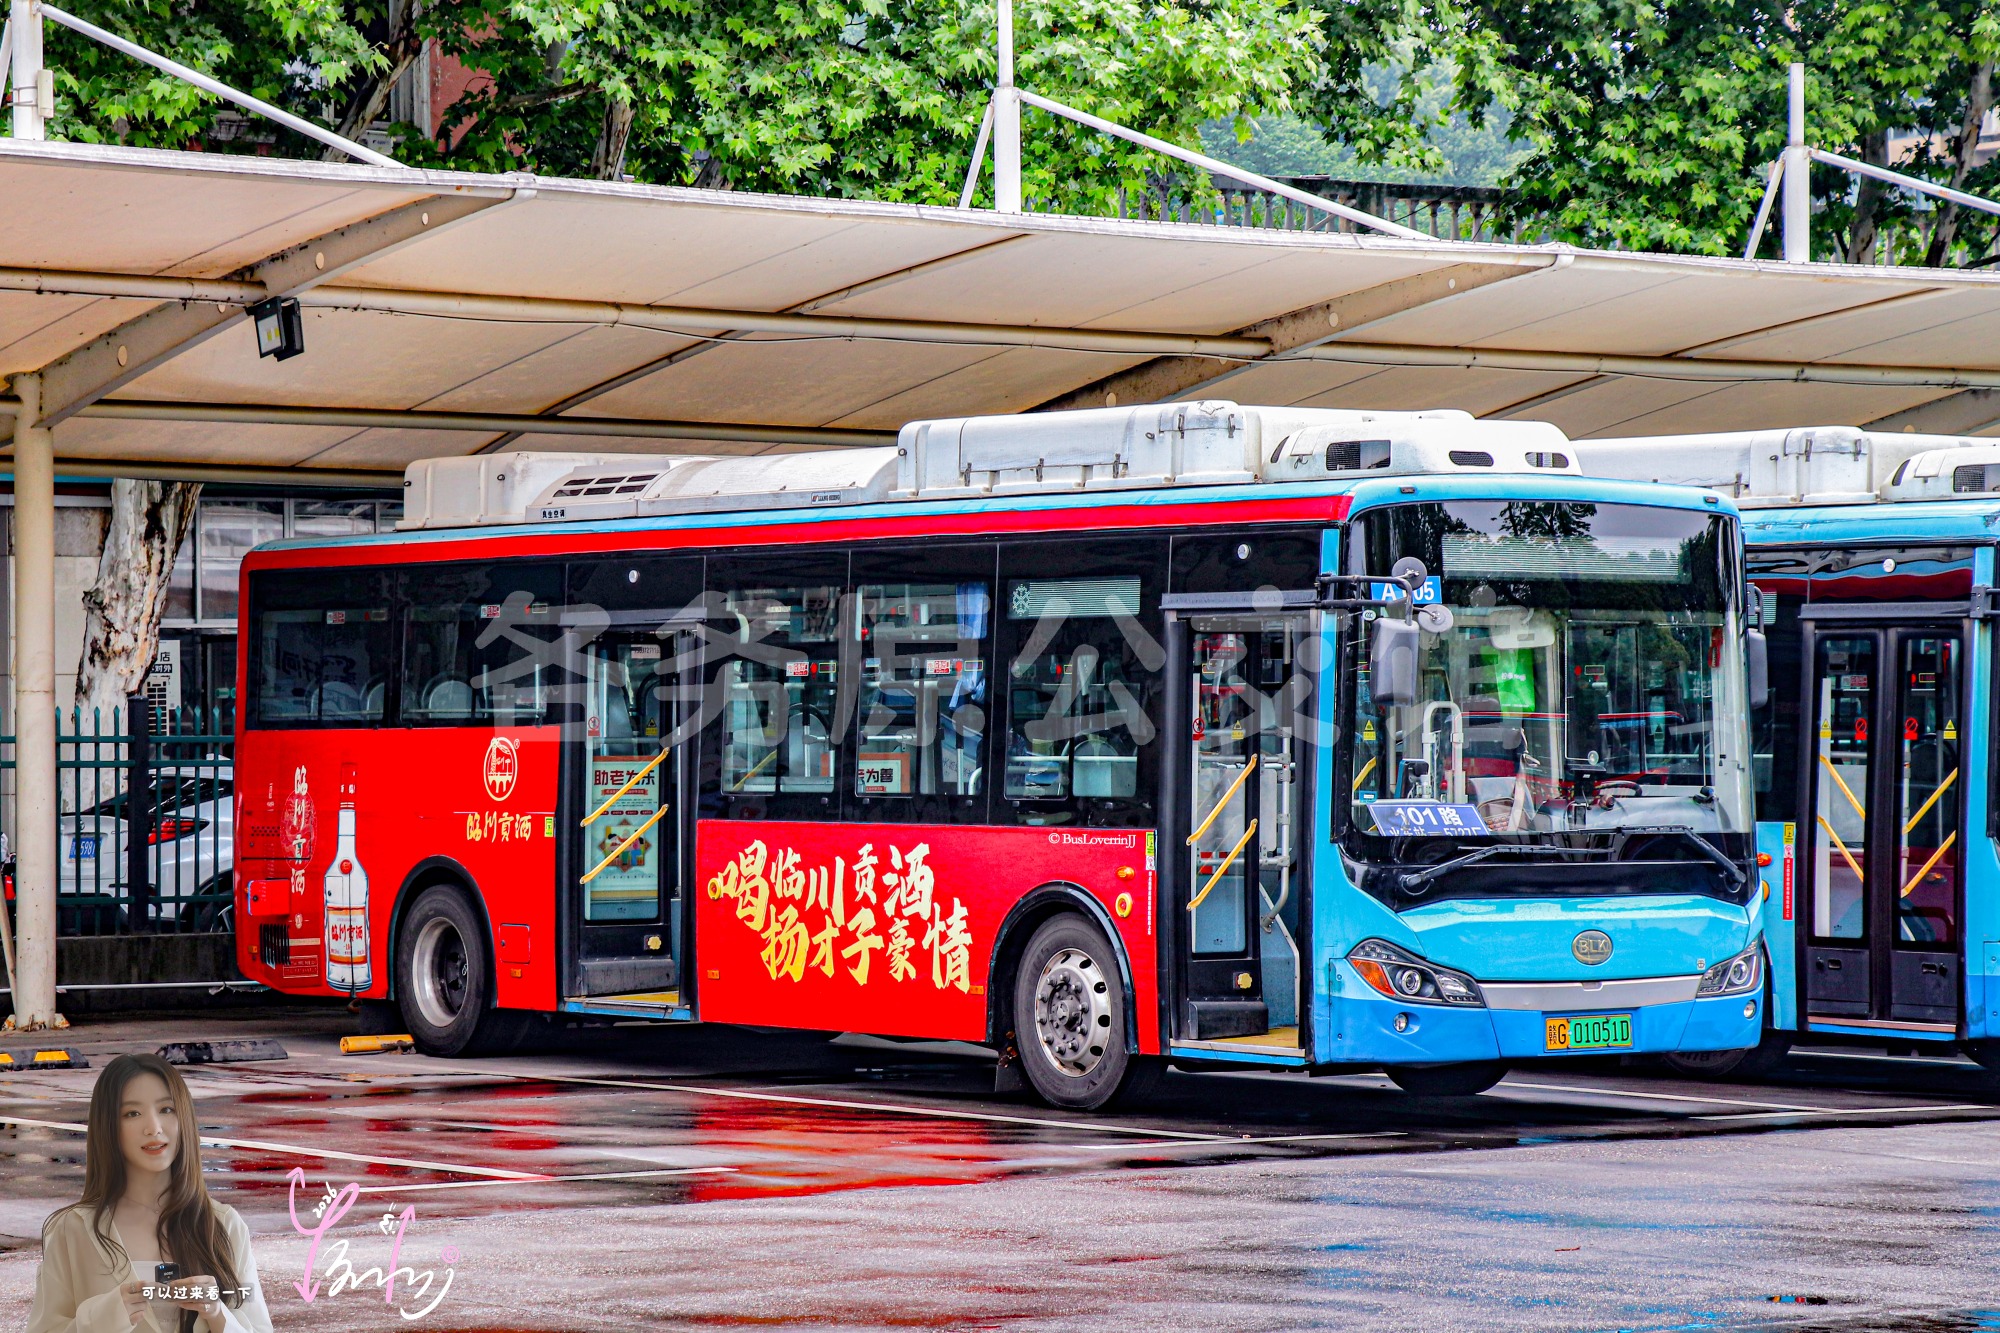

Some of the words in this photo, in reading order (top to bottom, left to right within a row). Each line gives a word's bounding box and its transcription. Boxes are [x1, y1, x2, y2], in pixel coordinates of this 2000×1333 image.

[1381, 582, 1435, 601] A05
[718, 839, 935, 932] 喝临川贡酒
[759, 897, 974, 995] 扬才子豪情
